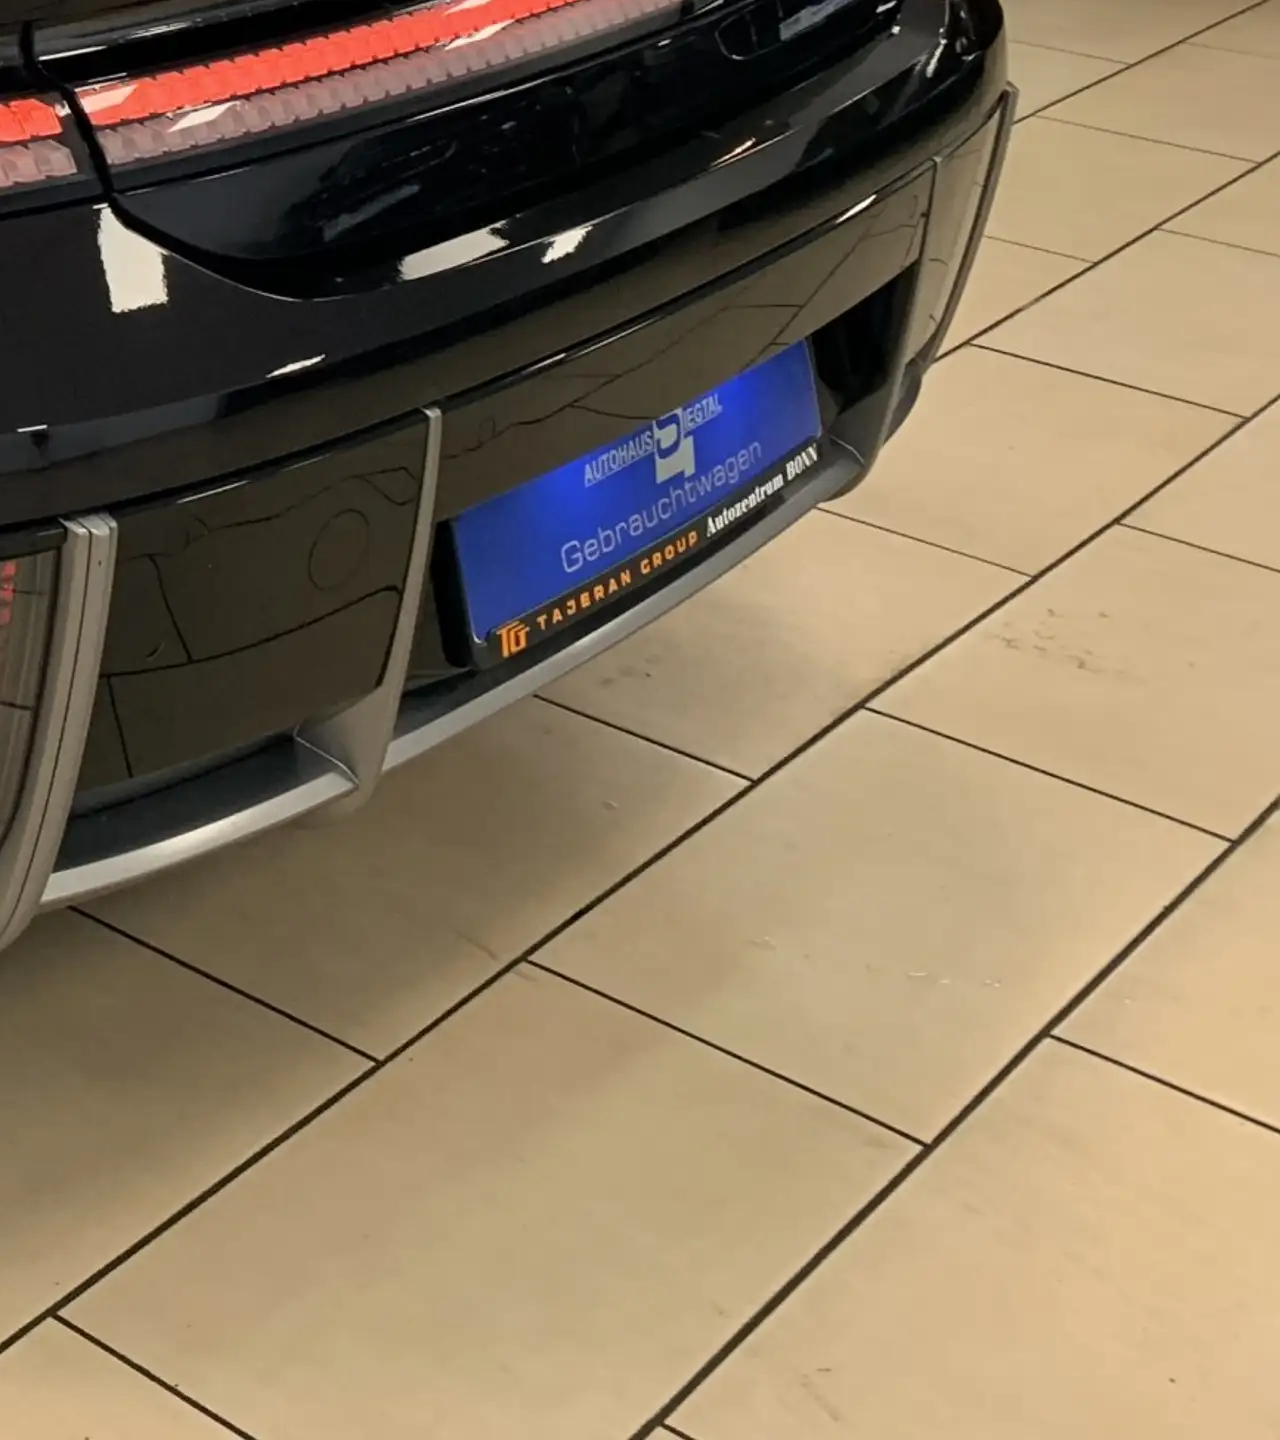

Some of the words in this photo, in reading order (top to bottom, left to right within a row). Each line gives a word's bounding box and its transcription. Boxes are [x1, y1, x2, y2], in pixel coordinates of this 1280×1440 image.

[560, 440, 763, 574] Gebrauchtwagen
[584, 429, 654, 488] AUTOHAUS
[536, 568, 632, 631] TAJERAN
[640, 530, 699, 575] GROUP
[706, 477, 785, 537] Autozentrum
[785, 443, 819, 481] BONN
